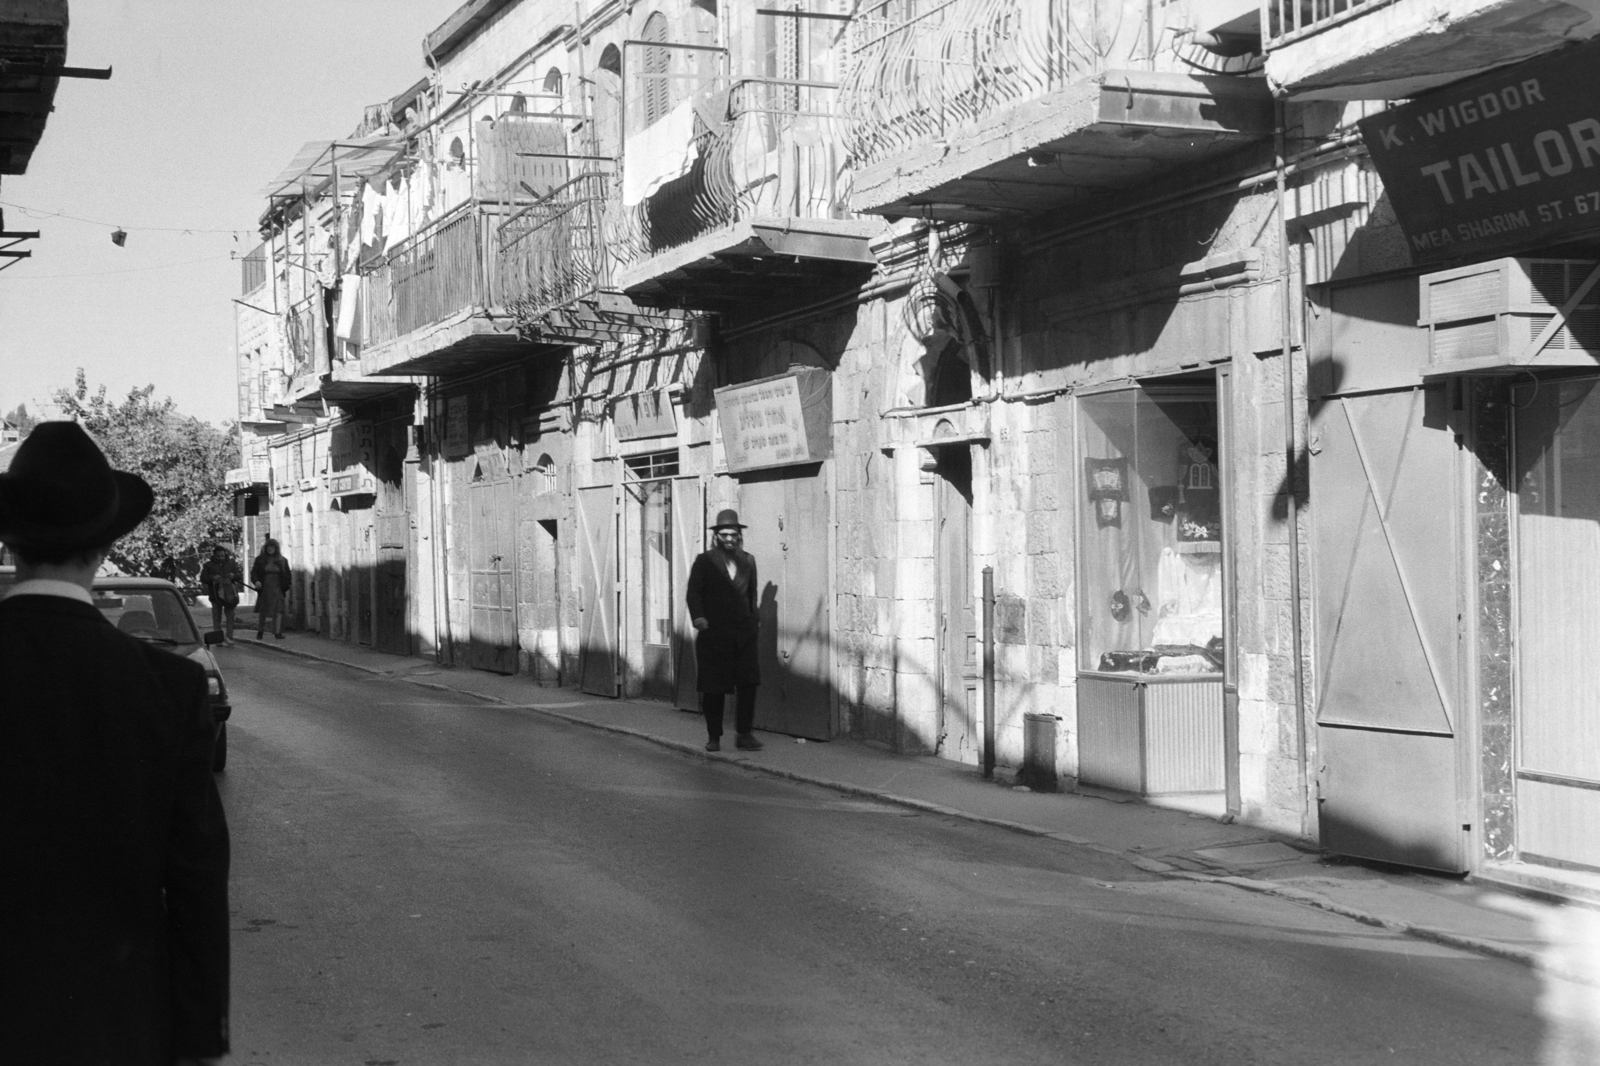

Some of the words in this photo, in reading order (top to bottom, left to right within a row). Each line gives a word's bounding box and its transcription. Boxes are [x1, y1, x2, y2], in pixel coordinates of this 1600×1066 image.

[1379, 125, 1415, 150] K.
[1418, 78, 1546, 137] WIGDOR
[1420, 118, 1600, 205] TAILOR
[1412, 228, 1454, 252] MEA
[1457, 209, 1531, 241] SHARIM
